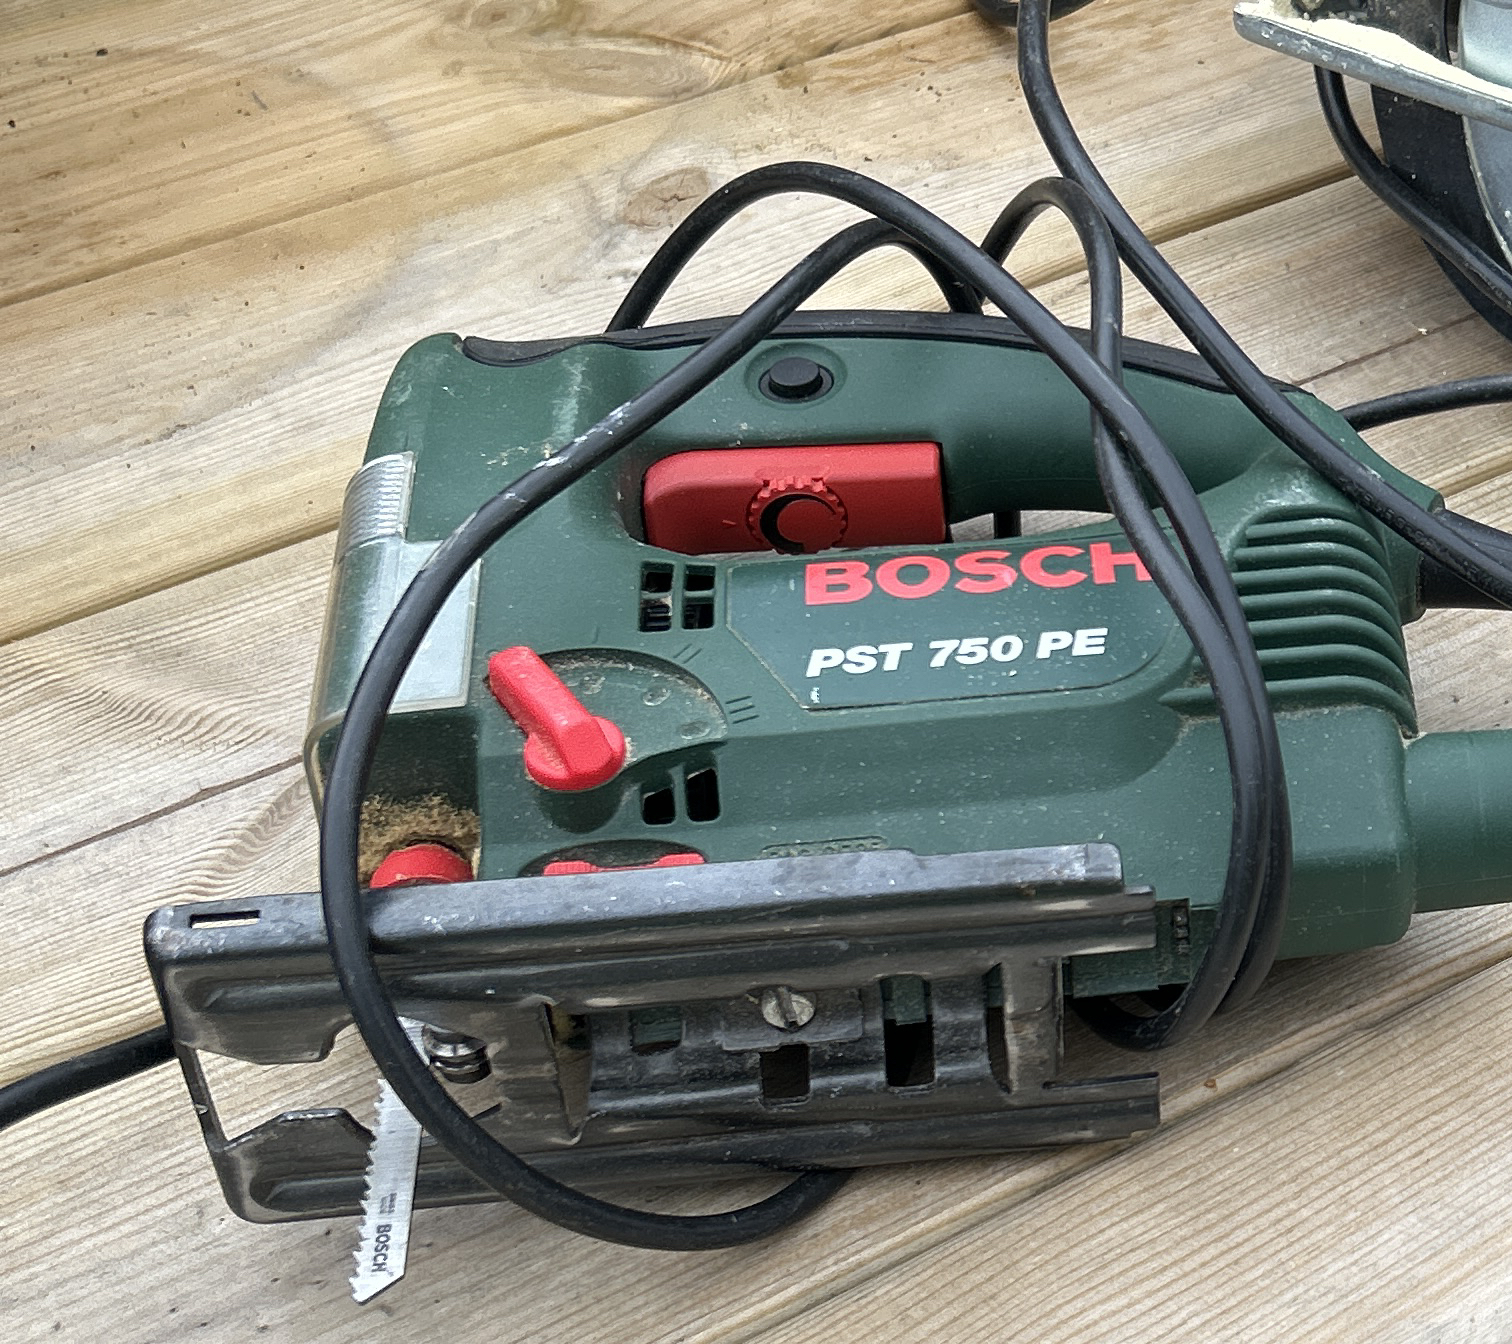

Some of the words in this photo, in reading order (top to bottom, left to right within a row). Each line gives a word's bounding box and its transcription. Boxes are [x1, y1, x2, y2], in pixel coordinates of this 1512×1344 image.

[804, 542, 1153, 605] BOSCH
[805, 642, 914, 678] PST
[929, 634, 1024, 668] 750
[1035, 628, 1108, 660] PE
[371, 1223, 392, 1273] BOSCH
